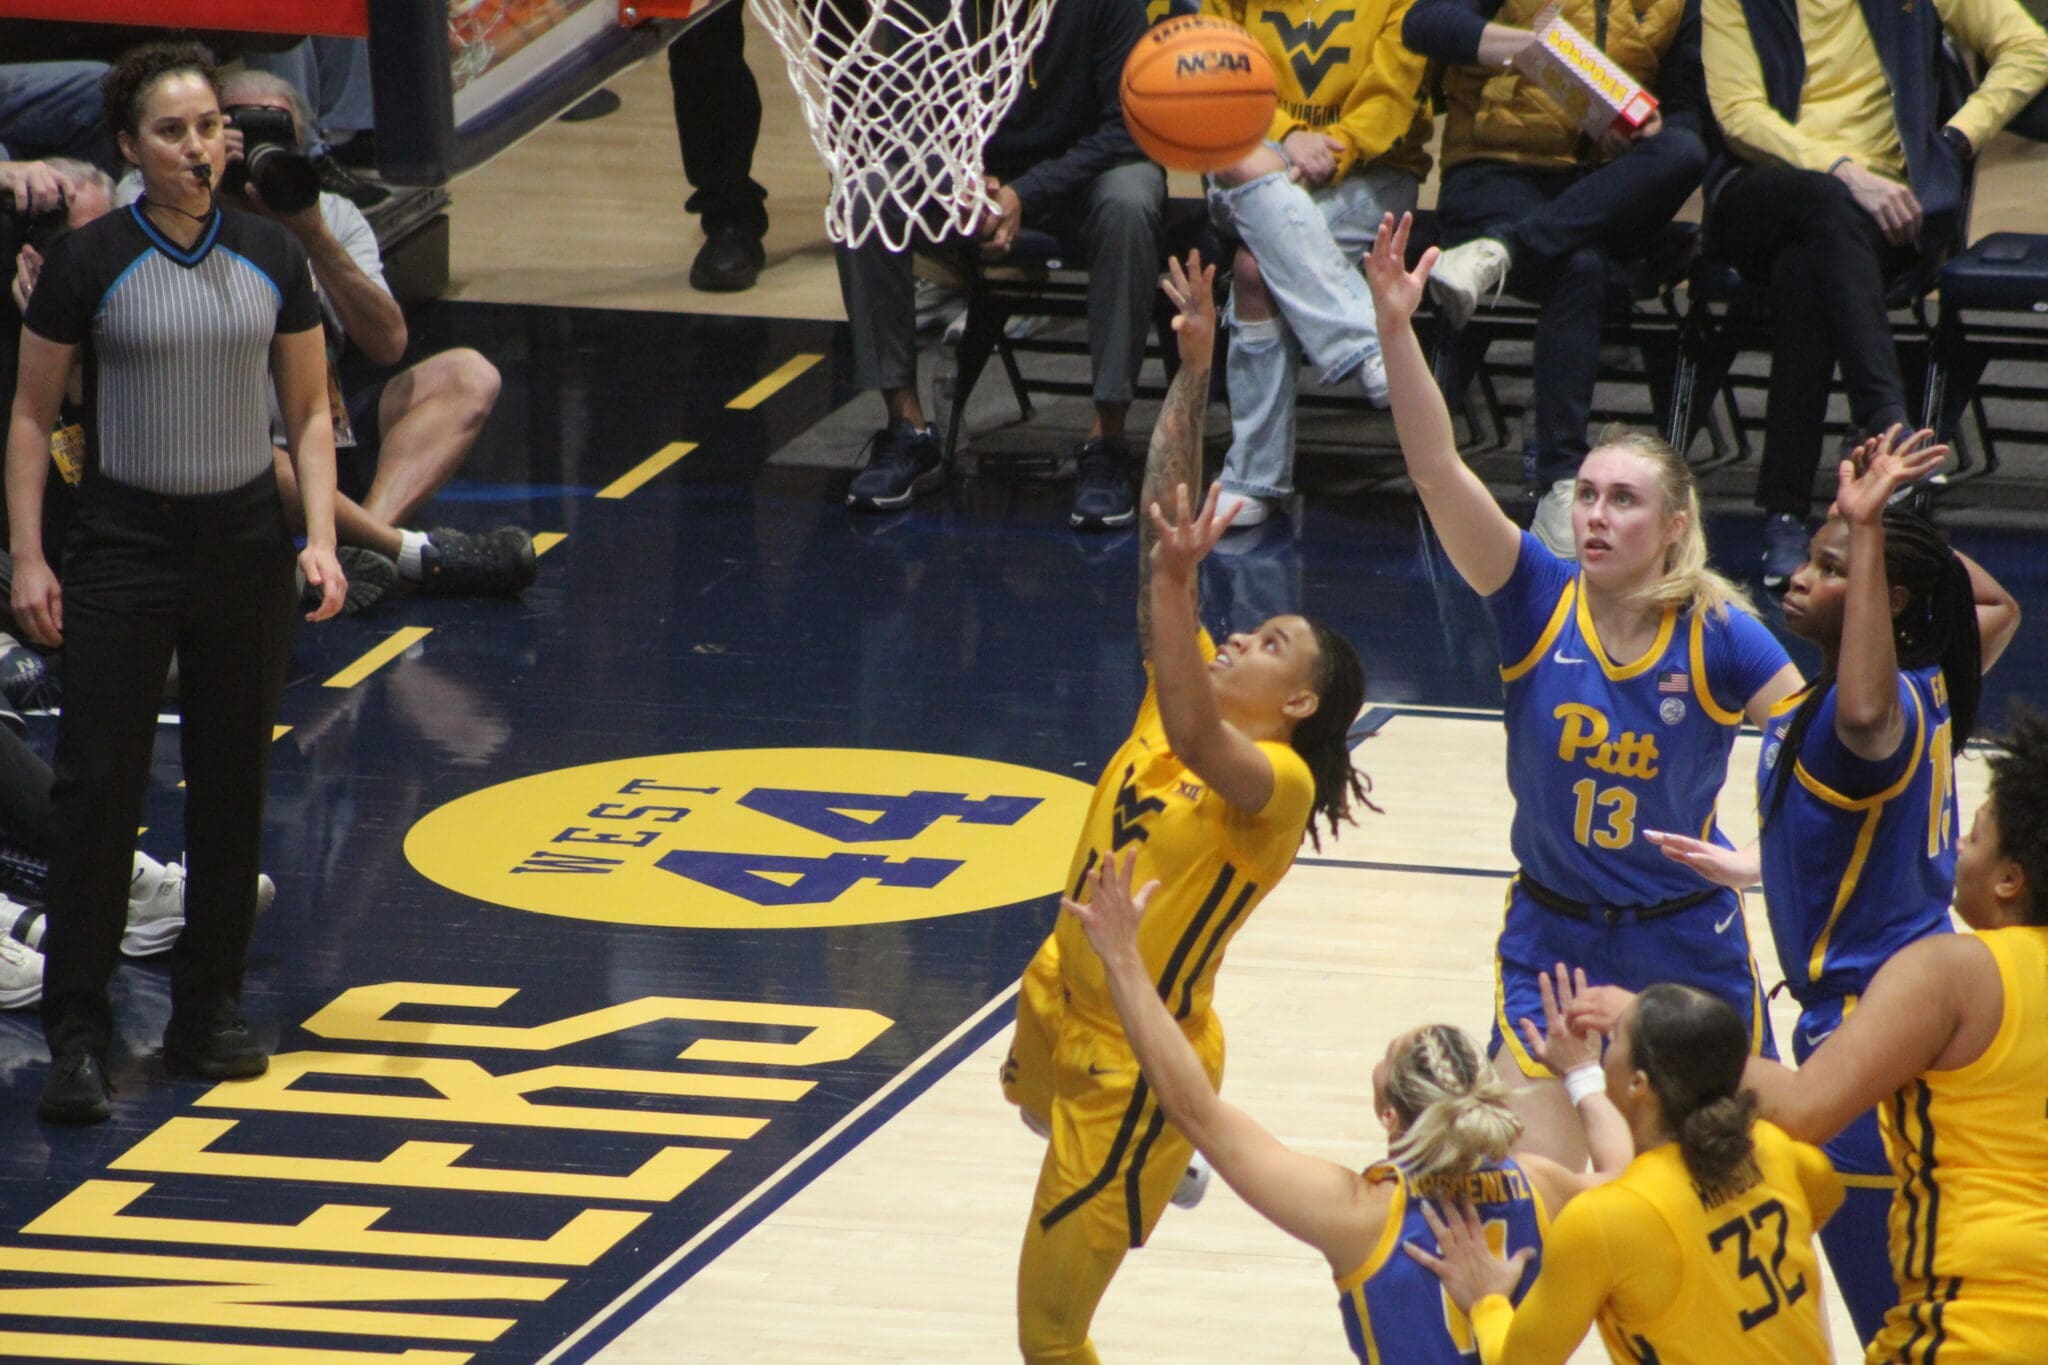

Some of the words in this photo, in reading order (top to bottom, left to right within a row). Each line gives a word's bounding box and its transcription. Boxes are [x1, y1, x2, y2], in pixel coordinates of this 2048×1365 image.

[1176, 51, 1252, 78] NCAA
[1552, 702, 1660, 780] Pitt
[509, 778, 722, 875] WEST
[1572, 778, 1638, 849] 13
[1706, 1197, 1808, 1333] 32
